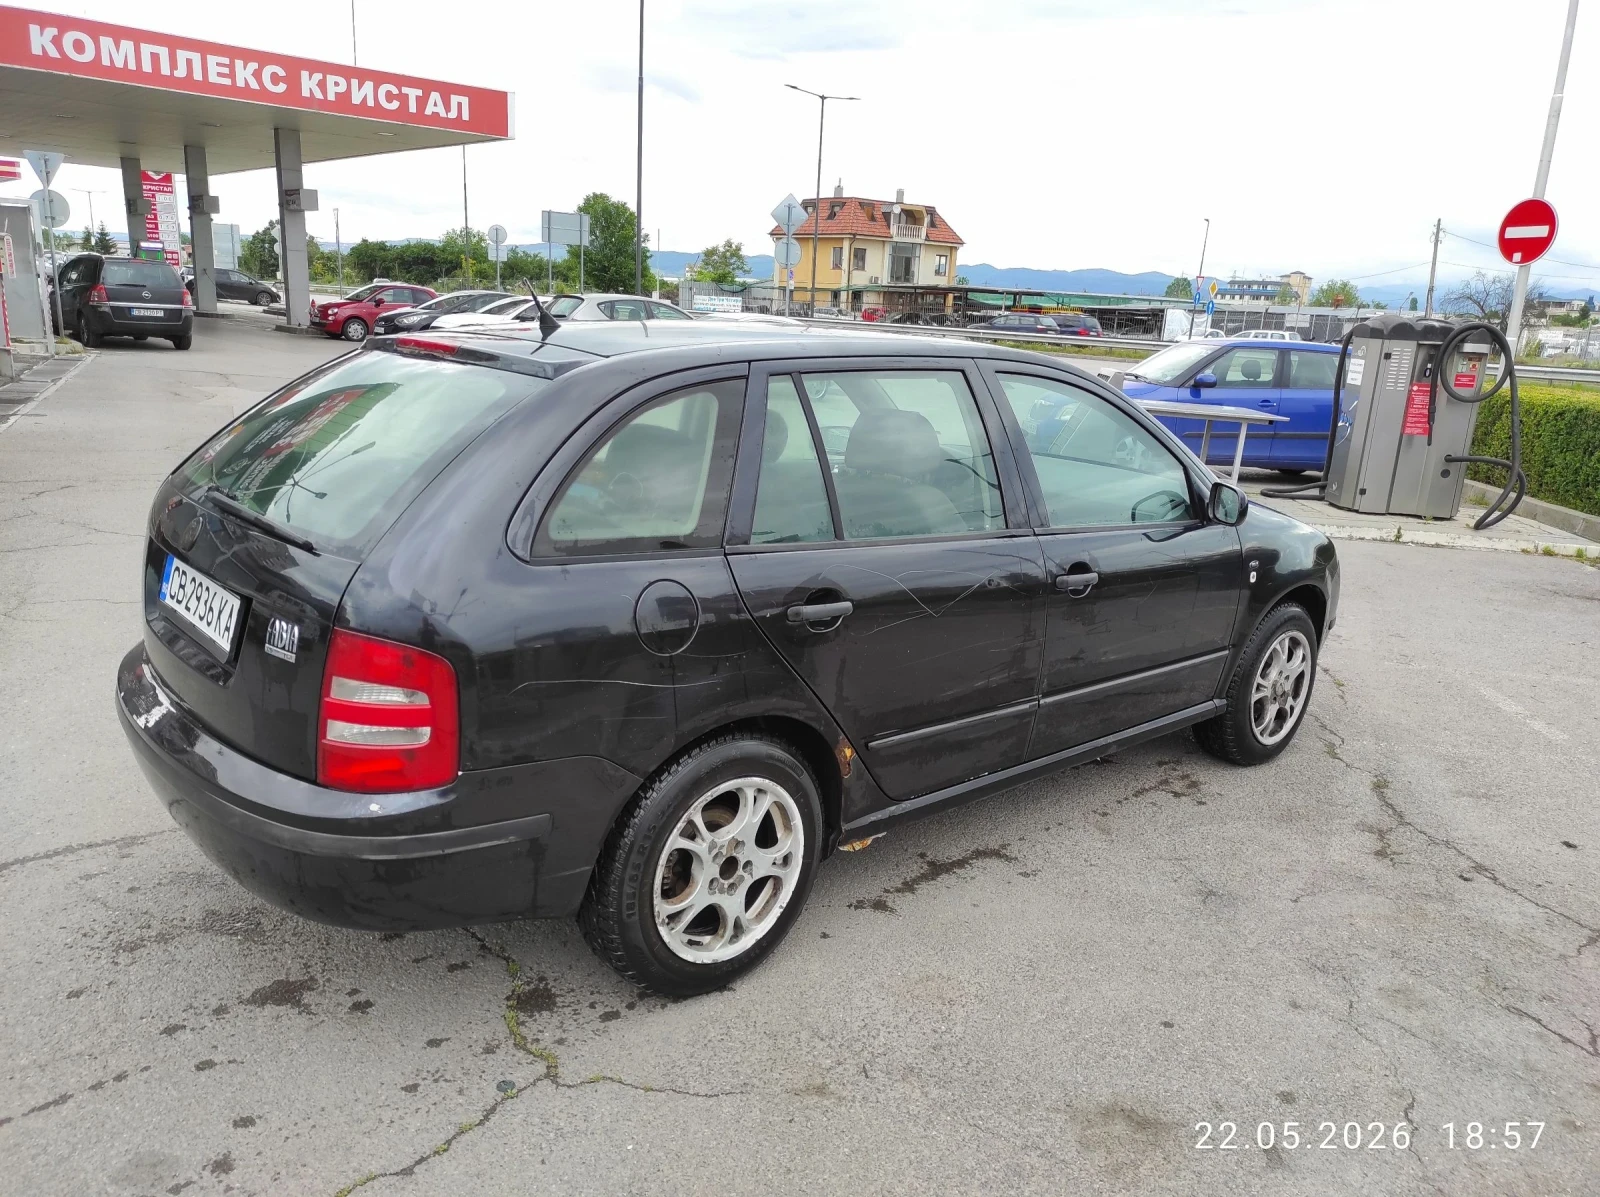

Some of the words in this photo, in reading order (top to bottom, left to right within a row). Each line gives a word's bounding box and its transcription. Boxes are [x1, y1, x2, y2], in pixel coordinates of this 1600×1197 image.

[28, 23, 288, 94] КОМПЛЕКС
[300, 70, 470, 121] КРИСТАЛ
[142, 184, 172, 192] КРИСТАЛ
[266, 617, 299, 653] FABIA
